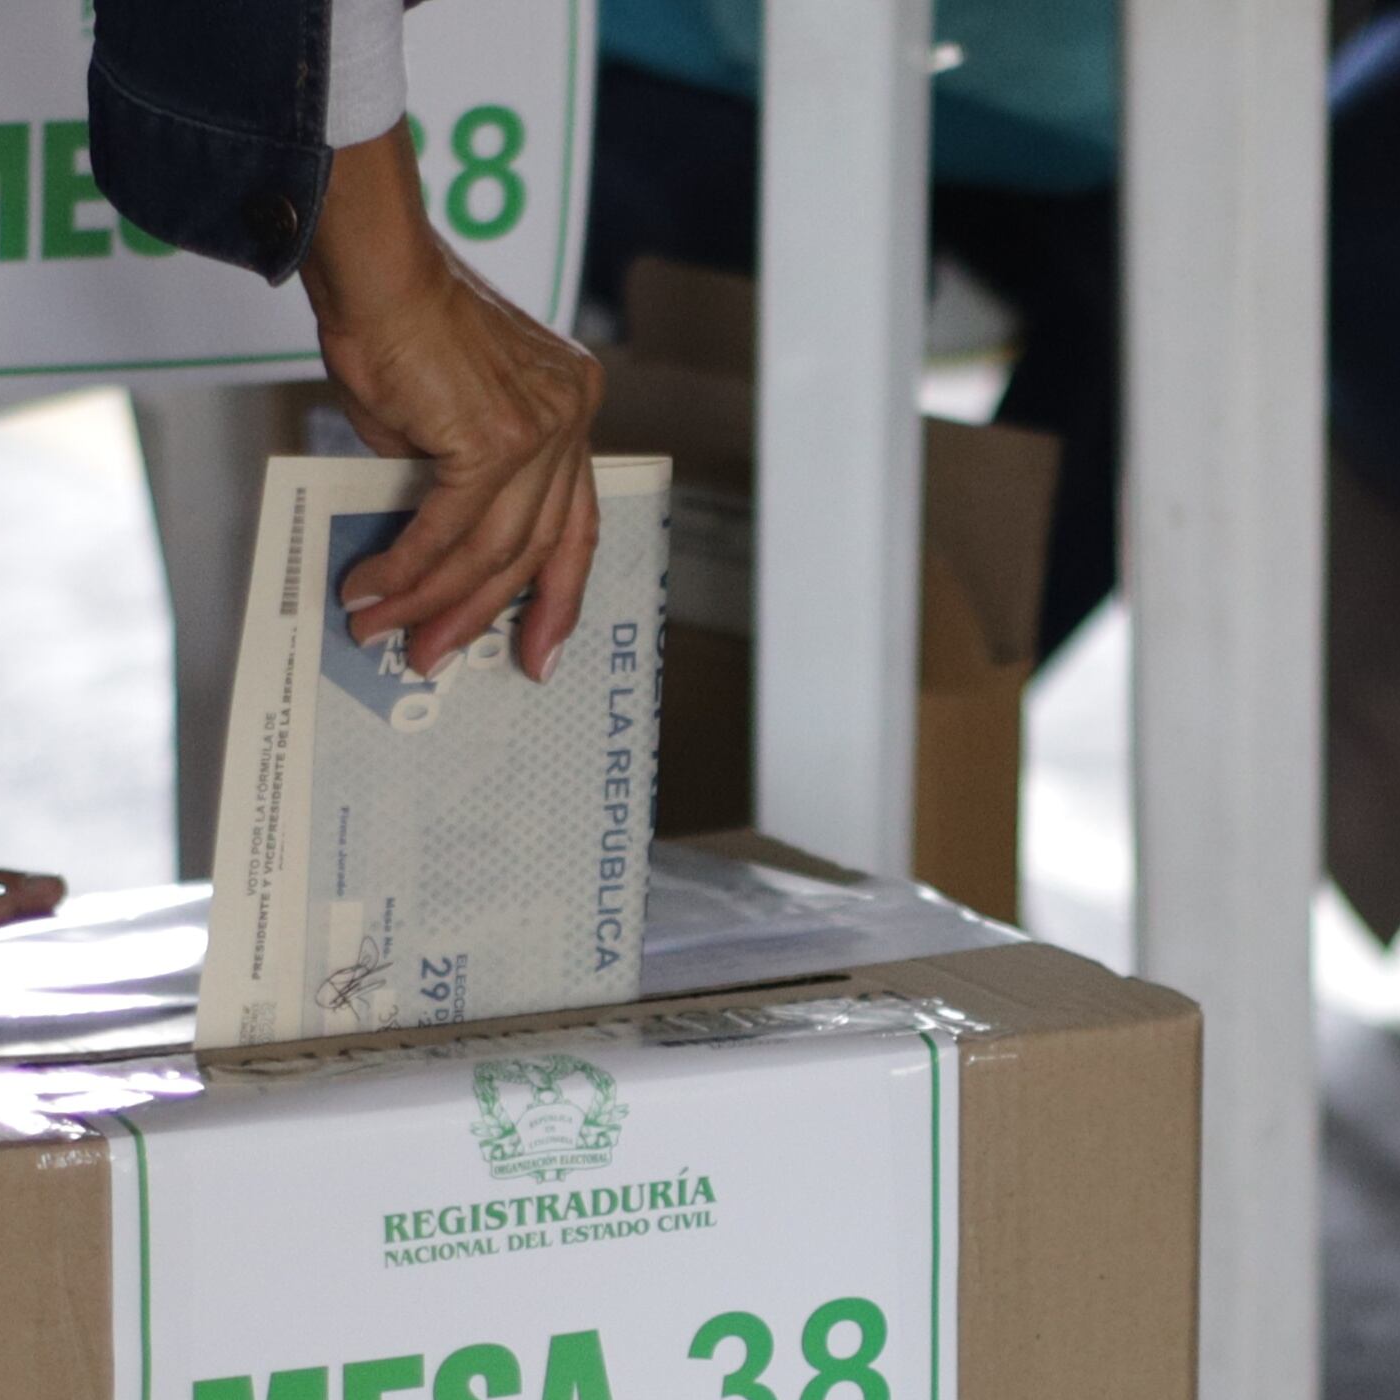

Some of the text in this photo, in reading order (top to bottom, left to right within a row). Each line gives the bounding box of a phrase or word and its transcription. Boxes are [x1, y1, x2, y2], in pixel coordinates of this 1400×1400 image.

[409, 104, 526, 241] 8
[595, 623, 638, 973] DE LA REPÚBLICA
[251, 892, 271, 981] PRESIDENTE
[420, 957, 451, 1001] 29
[451, 953, 469, 1024] ELECCIO
[383, 1167, 717, 1243] REGISTRADURÍA
[384, 1210, 718, 1268] NACIONAL DEL ESTADO CIVIL
